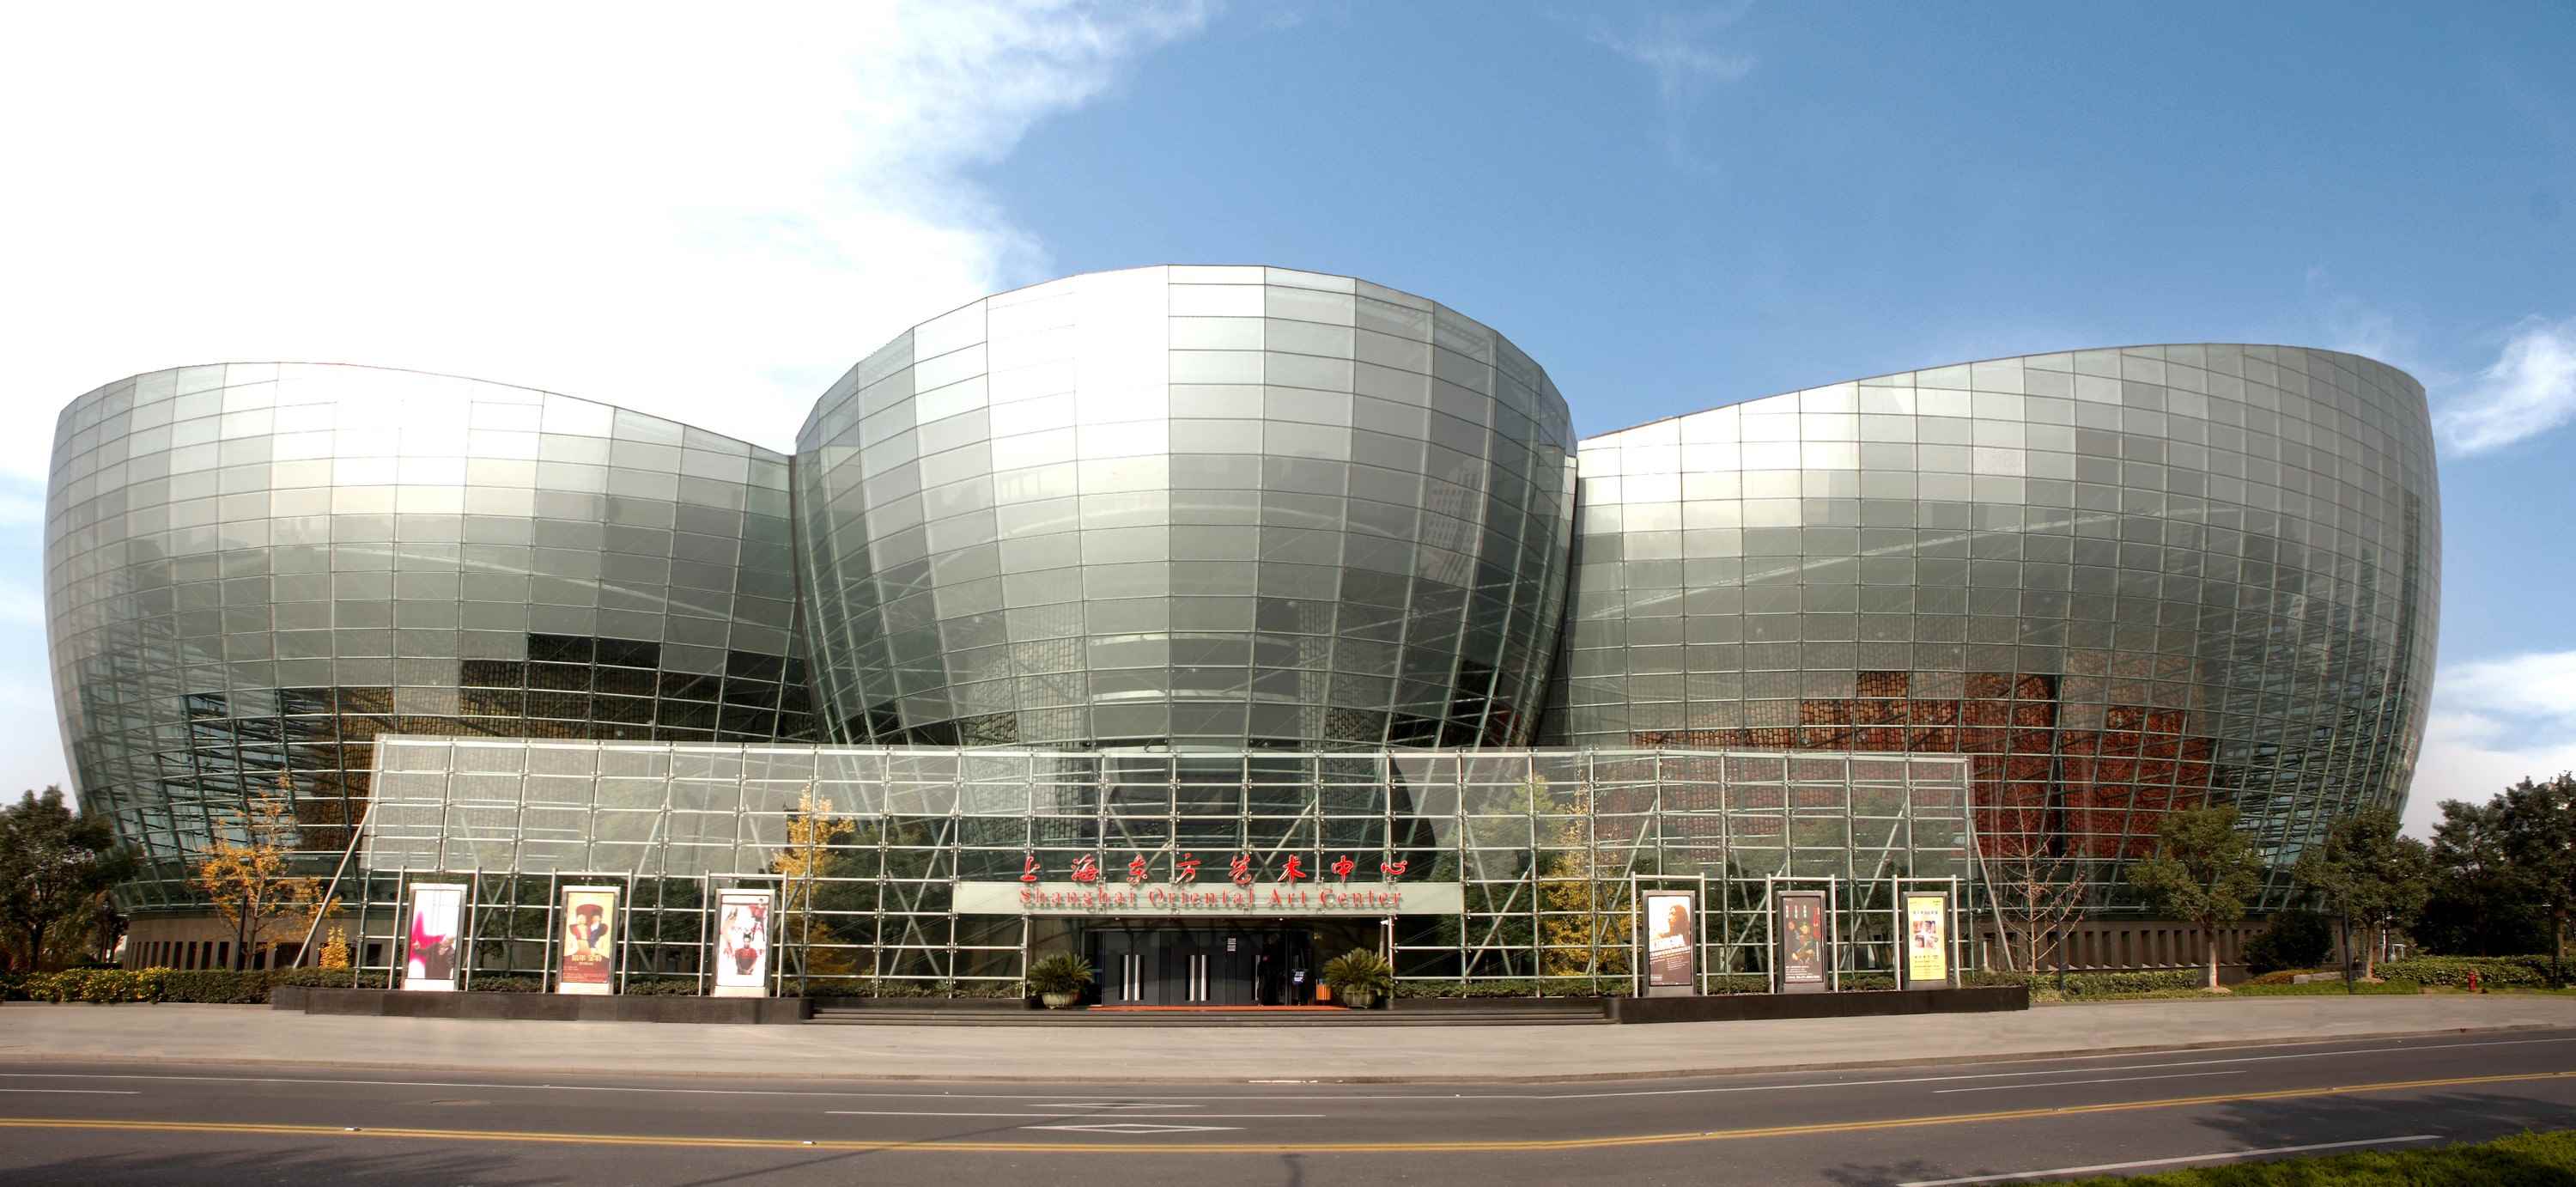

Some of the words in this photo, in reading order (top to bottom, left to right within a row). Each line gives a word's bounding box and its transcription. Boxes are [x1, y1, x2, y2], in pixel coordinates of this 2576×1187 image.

[1019, 853, 1408, 886] 上海东方艺术中心
[1018, 886, 1137, 908] Shanghai
[1149, 888, 1255, 908] Oriental
[1269, 888, 1308, 908] Art
[1319, 888, 1403, 908] Center
